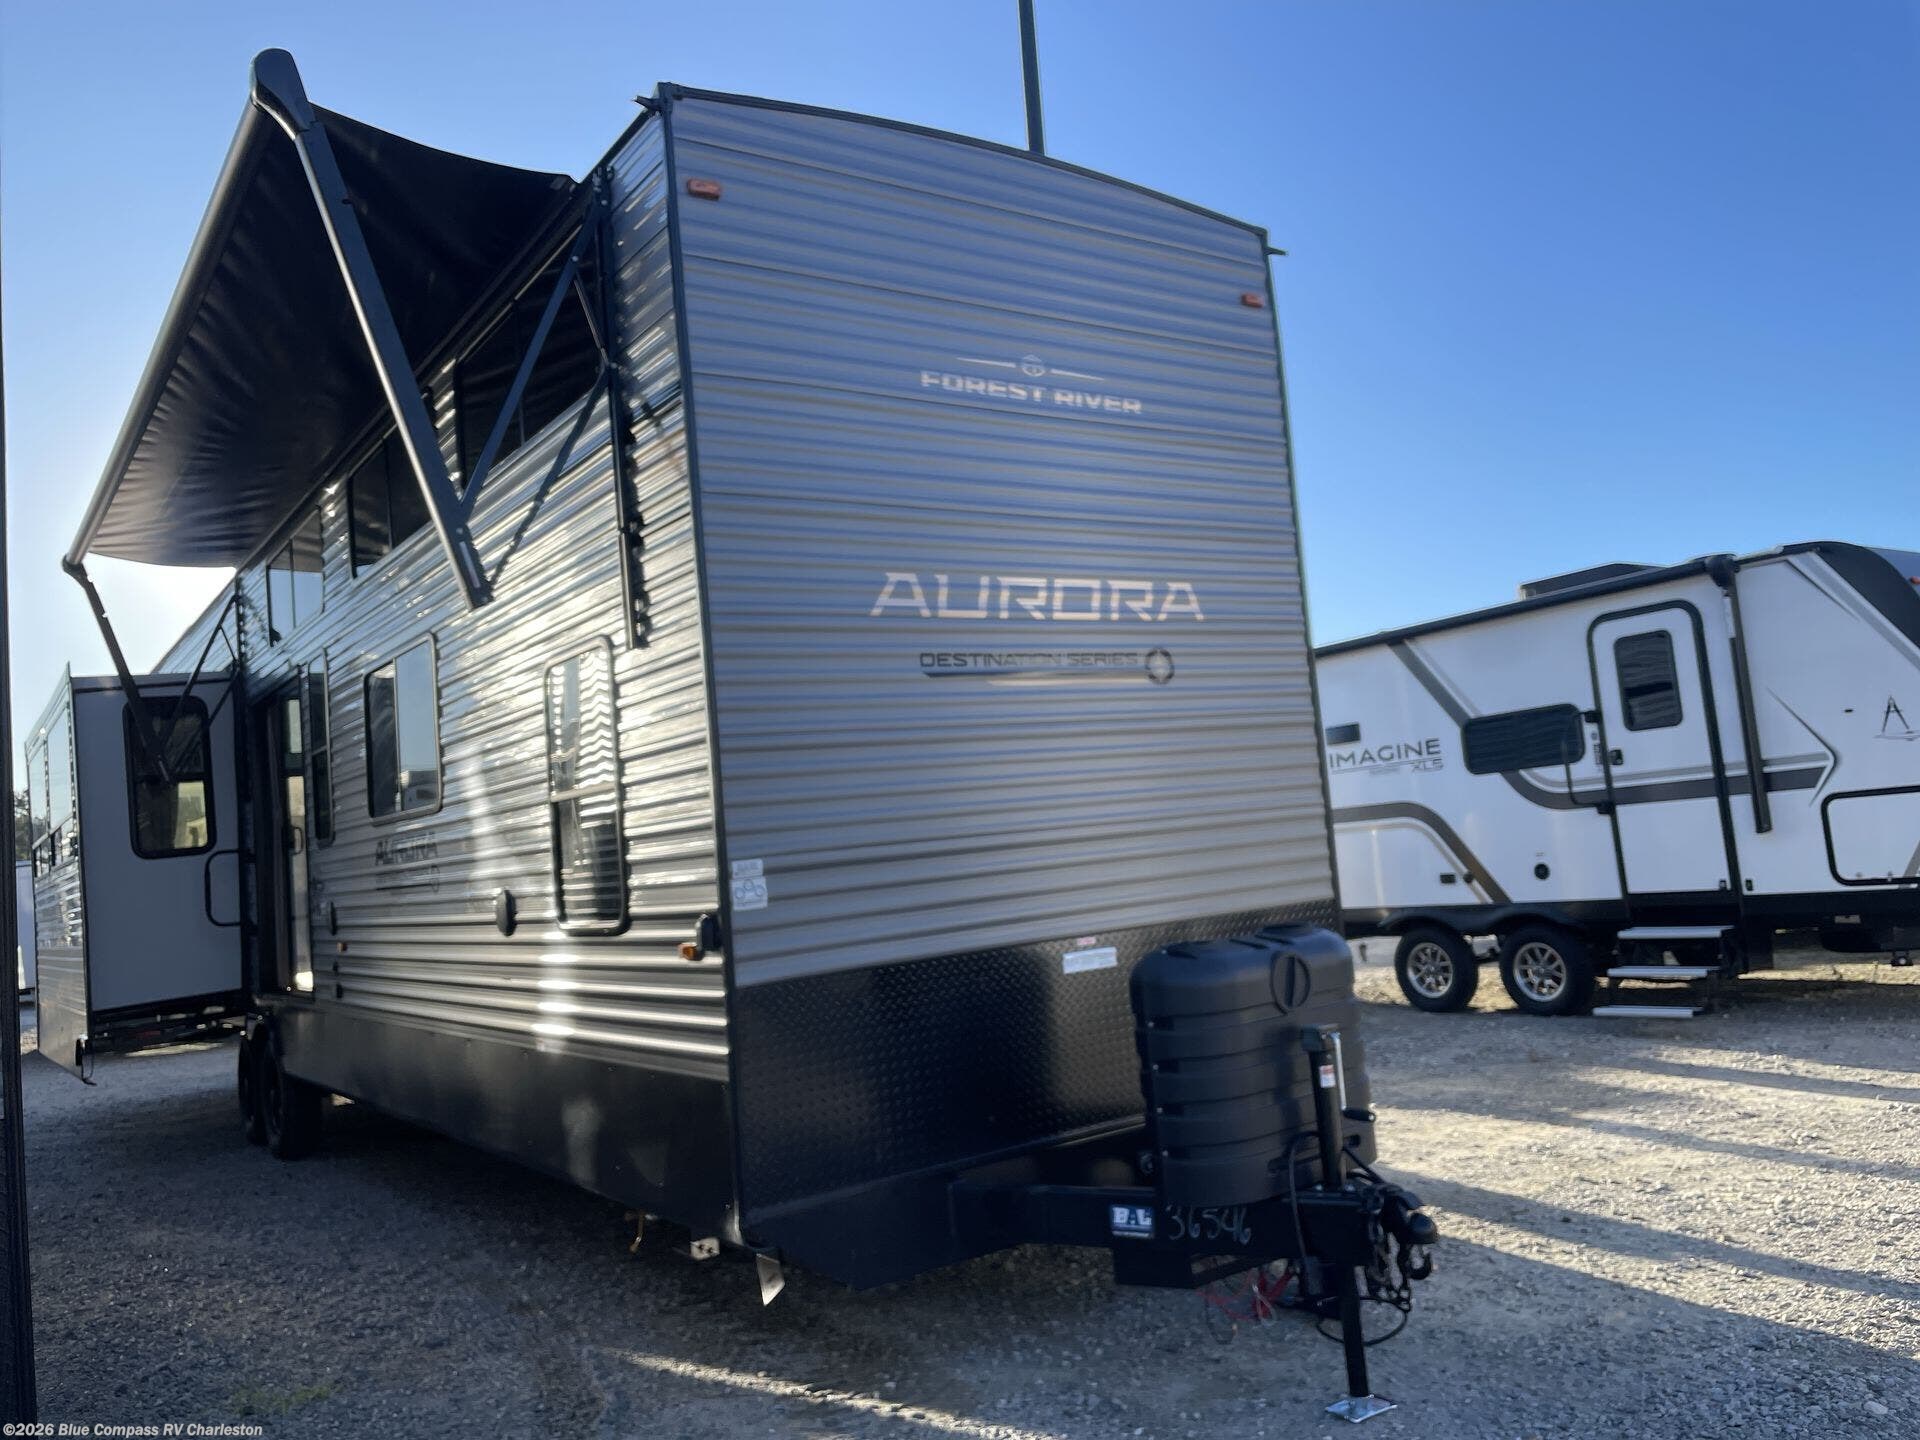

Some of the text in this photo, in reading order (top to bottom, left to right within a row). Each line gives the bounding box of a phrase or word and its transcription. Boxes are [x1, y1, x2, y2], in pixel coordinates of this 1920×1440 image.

[920, 371, 1142, 414] FOREST RIVER
[869, 571, 1205, 621] AURORA
[919, 652, 1139, 667] DESTINATION SERIES
[1329, 737, 1442, 768] IMAGINE
